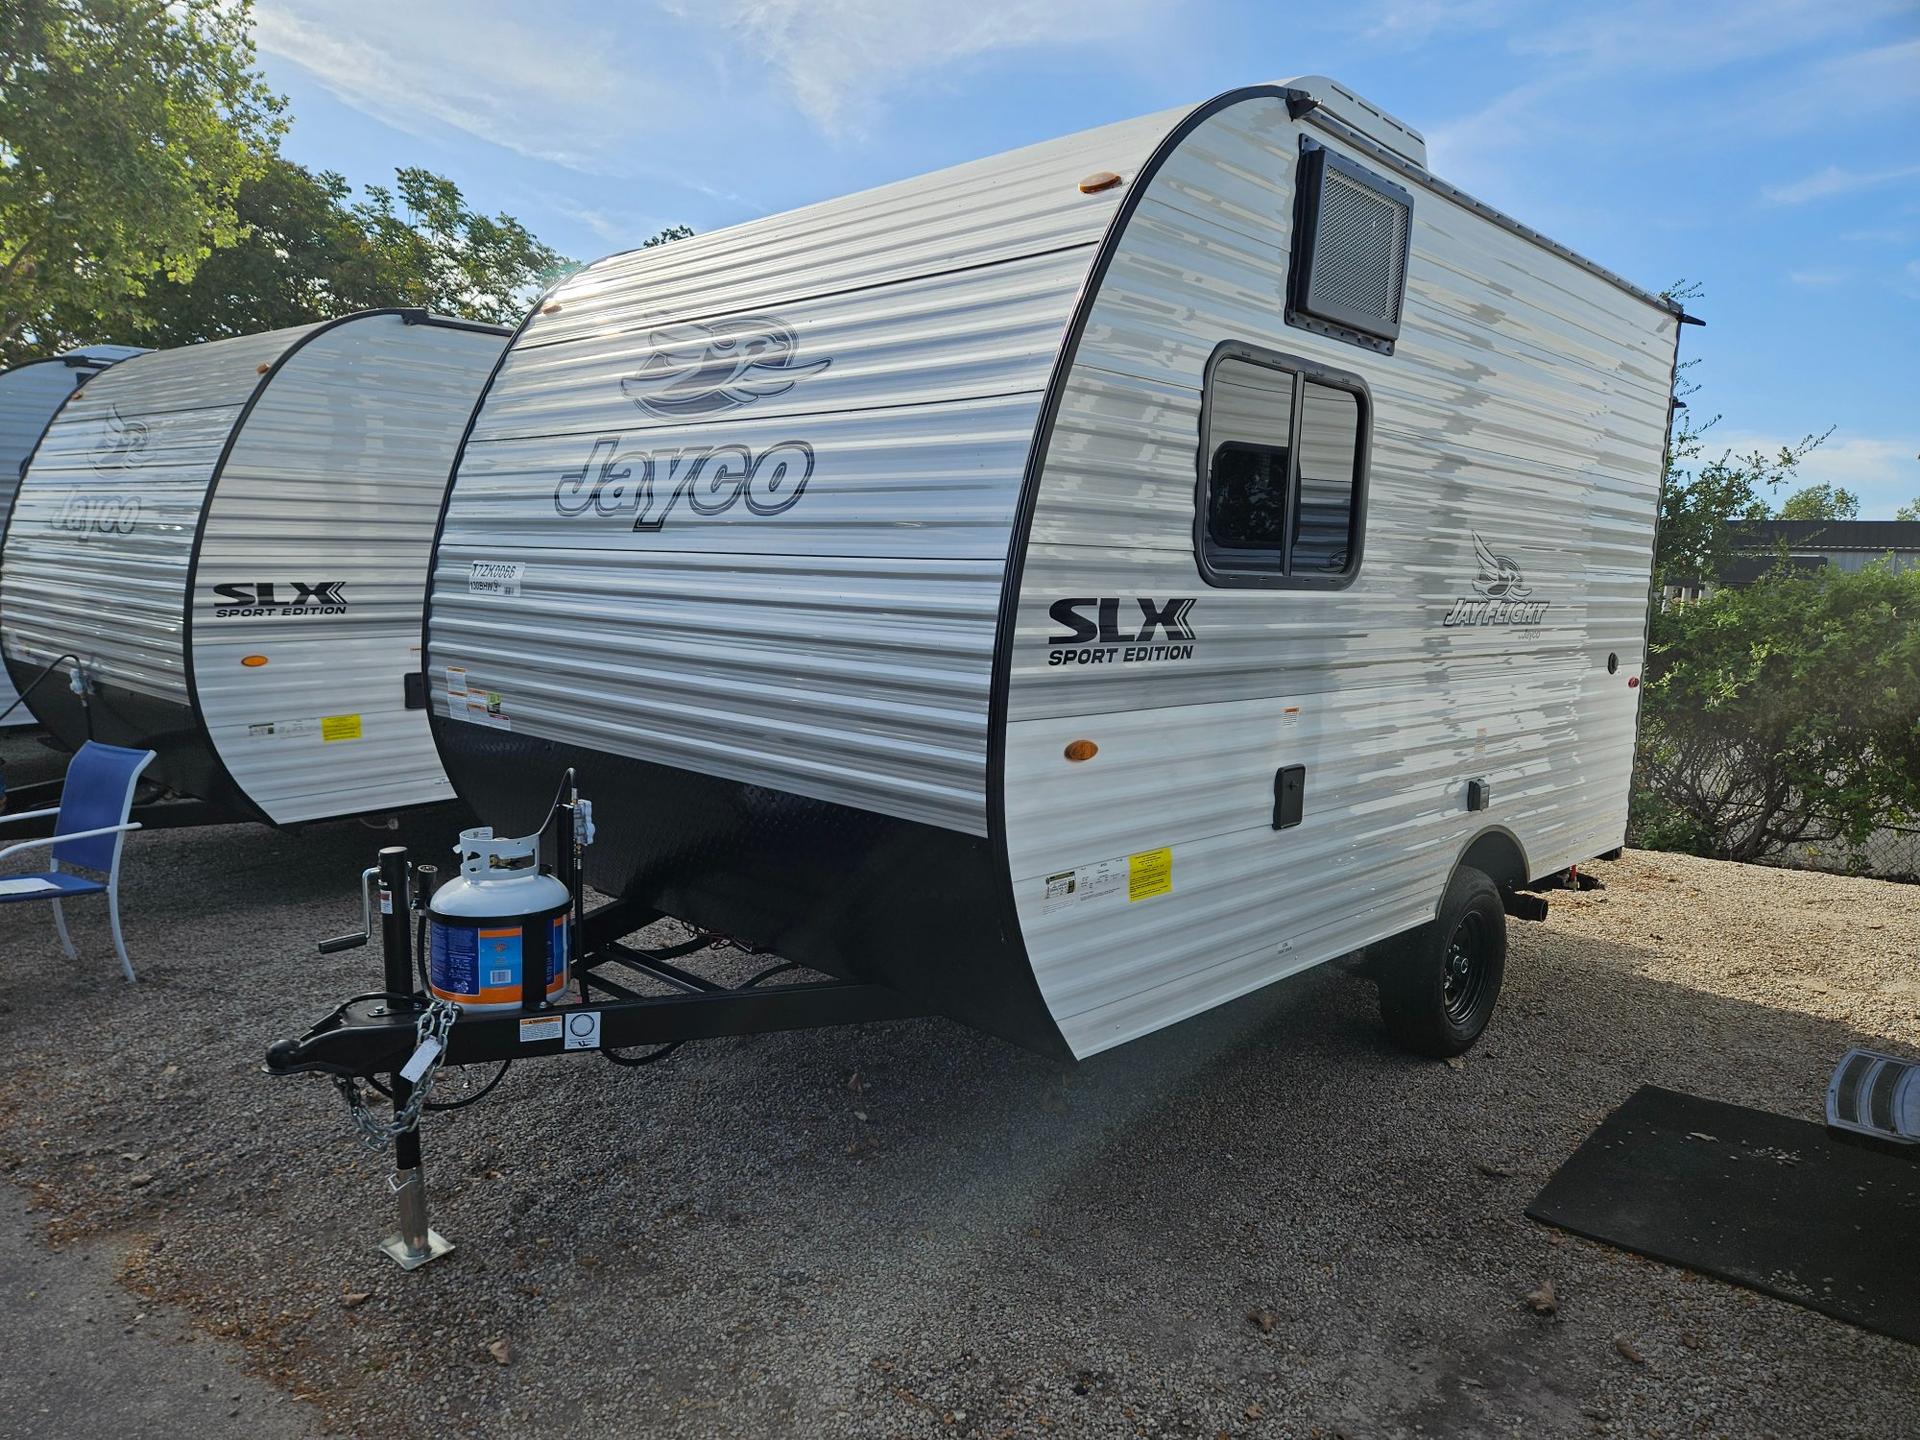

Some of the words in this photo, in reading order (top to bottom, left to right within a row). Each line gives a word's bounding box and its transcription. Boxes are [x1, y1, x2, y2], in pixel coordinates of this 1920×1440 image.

[554, 435, 814, 533] Jayco
[51, 484, 142, 543] Jayco
[213, 581, 348, 607] SLX
[216, 608, 276, 618] SPORT
[281, 606, 346, 616] EDITION
[1048, 597, 1197, 644] SLX
[1048, 648, 1119, 666] SPORT
[1123, 645, 1194, 663] EDITION
